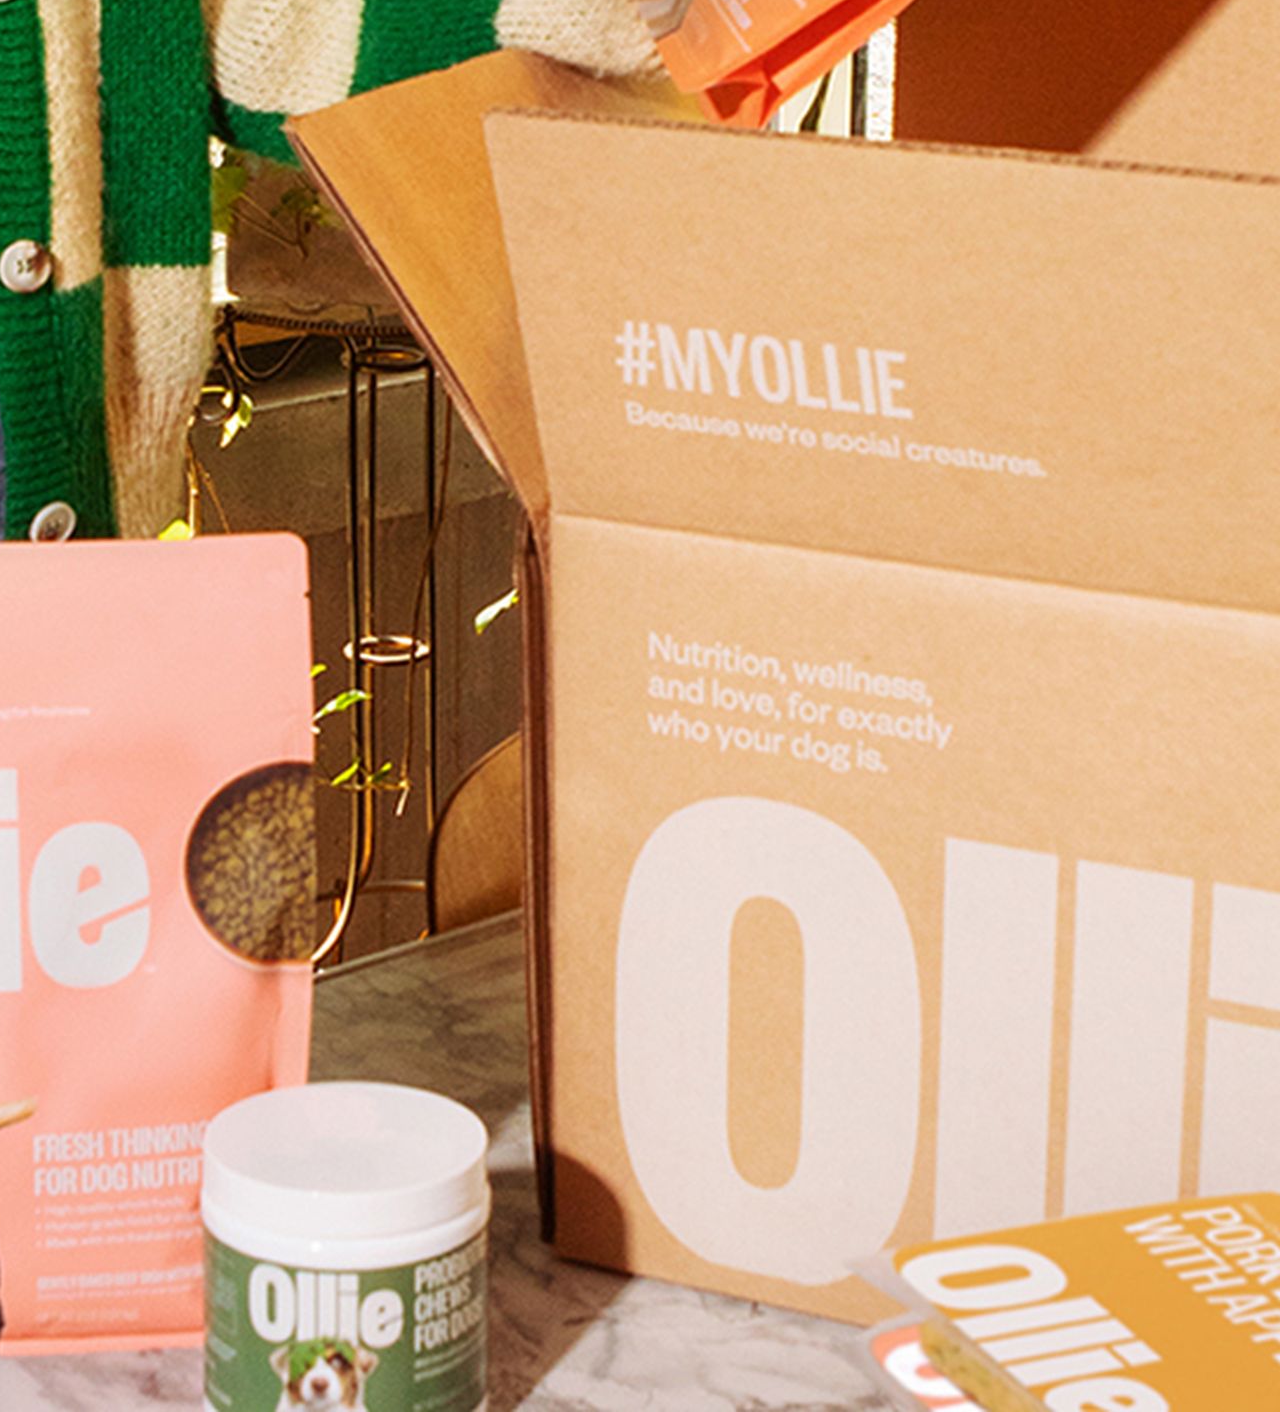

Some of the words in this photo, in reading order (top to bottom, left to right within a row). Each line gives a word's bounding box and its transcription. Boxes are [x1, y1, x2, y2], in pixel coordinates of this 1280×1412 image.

[614, 319, 914, 420] #MYOLLIE
[625, 401, 740, 438] Because
[744, 421, 817, 449] we're
[821, 431, 900, 459] social
[905, 441, 1048, 478] creatures.
[648, 631, 787, 684] Nutrition,
[792, 655, 934, 707] wellness,
[647, 709, 710, 743] who
[715, 722, 785, 755] your
[790, 732, 851, 773] dog
[856, 739, 890, 773] is.
[648, 672, 707, 705] and
[711, 678, 782, 724] love,
[787, 691, 832, 726] for
[836, 703, 953, 750] exactly
[33, 1132, 105, 1163] FRESH
[33, 1165, 78, 1197] FOR
[81, 1162, 128, 1193] DOG
[1123, 1213, 1247, 1293] WITH
[249, 1263, 405, 1349] Ollie
[413, 1317, 448, 1353] FOR
[901, 1244, 1172, 1412] Ollie
